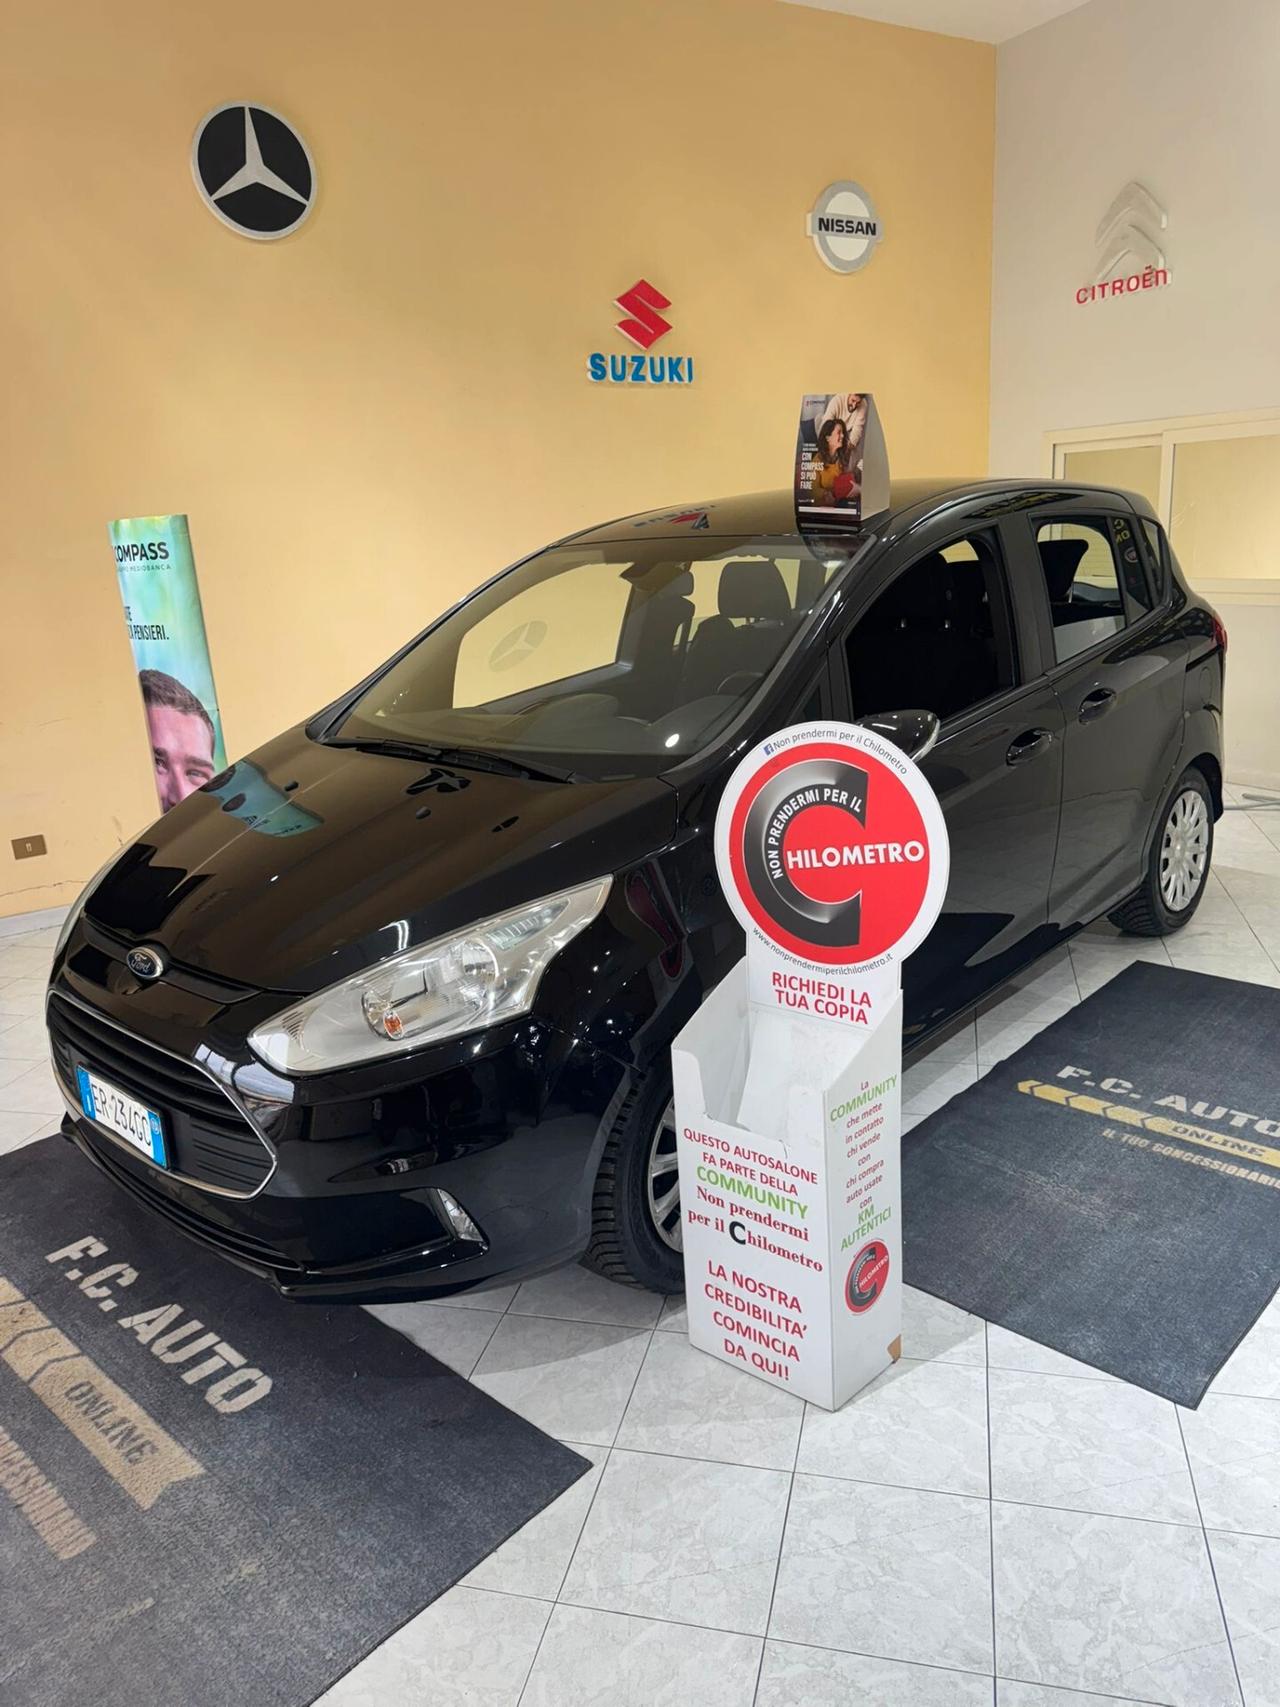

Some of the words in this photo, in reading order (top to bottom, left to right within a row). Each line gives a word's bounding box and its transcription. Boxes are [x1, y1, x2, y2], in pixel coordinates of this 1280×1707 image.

[818, 217, 877, 236] NISSAN
[588, 352, 694, 383] SUZUKI
[801, 462, 824, 471] COMPASS
[800, 481, 812, 489] FARE
[773, 736, 791, 750] Non
[792, 728, 837, 744] prendermi
[839, 731, 854, 743] per
[856, 734, 863, 744] il
[863, 737, 908, 775] Chilometro
[823, 788, 848, 805] PER
[850, 796, 863, 813] IL
[768, 788, 820, 845] PRENDERMI
[767, 850, 783, 879] NON
[753, 927, 893, 976] www.nonprendermiperilchilometro.it
[772, 971, 845, 1002] RICHIEDI
[850, 989, 872, 1008] LA
[775, 988, 809, 1010] TUA
[814, 998, 868, 1024] COPIA
[830, 1074, 897, 1122] COMMUNITY
[860, 1080, 869, 1091] La
[1056, 1065, 1142, 1099] F.C.
[1154, 1094, 1280, 1138] AUTO
[845, 1134, 853, 1144] in
[854, 1116, 884, 1140] contatto
[846, 1117, 860, 1129] che
[861, 1103, 882, 1121] mette
[847, 1144, 858, 1158] chi
[859, 1132, 880, 1150] vende
[1102, 1128, 1116, 1139] IL
[1121, 1132, 1151, 1148] TUO
[1172, 1126, 1267, 1158] ONLINE
[683, 1128, 730, 1152] QUESTO
[733, 1145, 818, 1185] AUTOSALONE
[857, 1153, 871, 1166] con
[702, 1152, 717, 1166] FA
[719, 1158, 756, 1181] PARTE
[760, 1172, 798, 1196] DELLA
[846, 1175, 857, 1188] chi
[858, 1159, 884, 1181] compra
[846, 1188, 863, 1204] auto
[864, 1174, 883, 1192] usate
[696, 1165, 808, 1219] COMMUNITY
[859, 1196, 872, 1209] con
[688, 1209, 711, 1225] per
[715, 1214, 725, 1233] il
[696, 1185, 725, 1209] Non
[729, 1202, 809, 1242] prendermi
[840, 1206, 892, 1252] AUTENTICI
[857, 1204, 875, 1225] KM
[708, 1260, 728, 1281] LA
[732, 1271, 802, 1314] NOSTRA
[45, 1235, 140, 1312] F.C.
[117, 1303, 273, 1414] AUTO
[704, 1283, 807, 1339] CREDIBILITA'
[713, 1311, 800, 1362] COMINCIA
[724, 1338, 747, 1361] DA
[751, 1352, 789, 1380] QUI!
[64, 1379, 160, 1466] ONLINE
